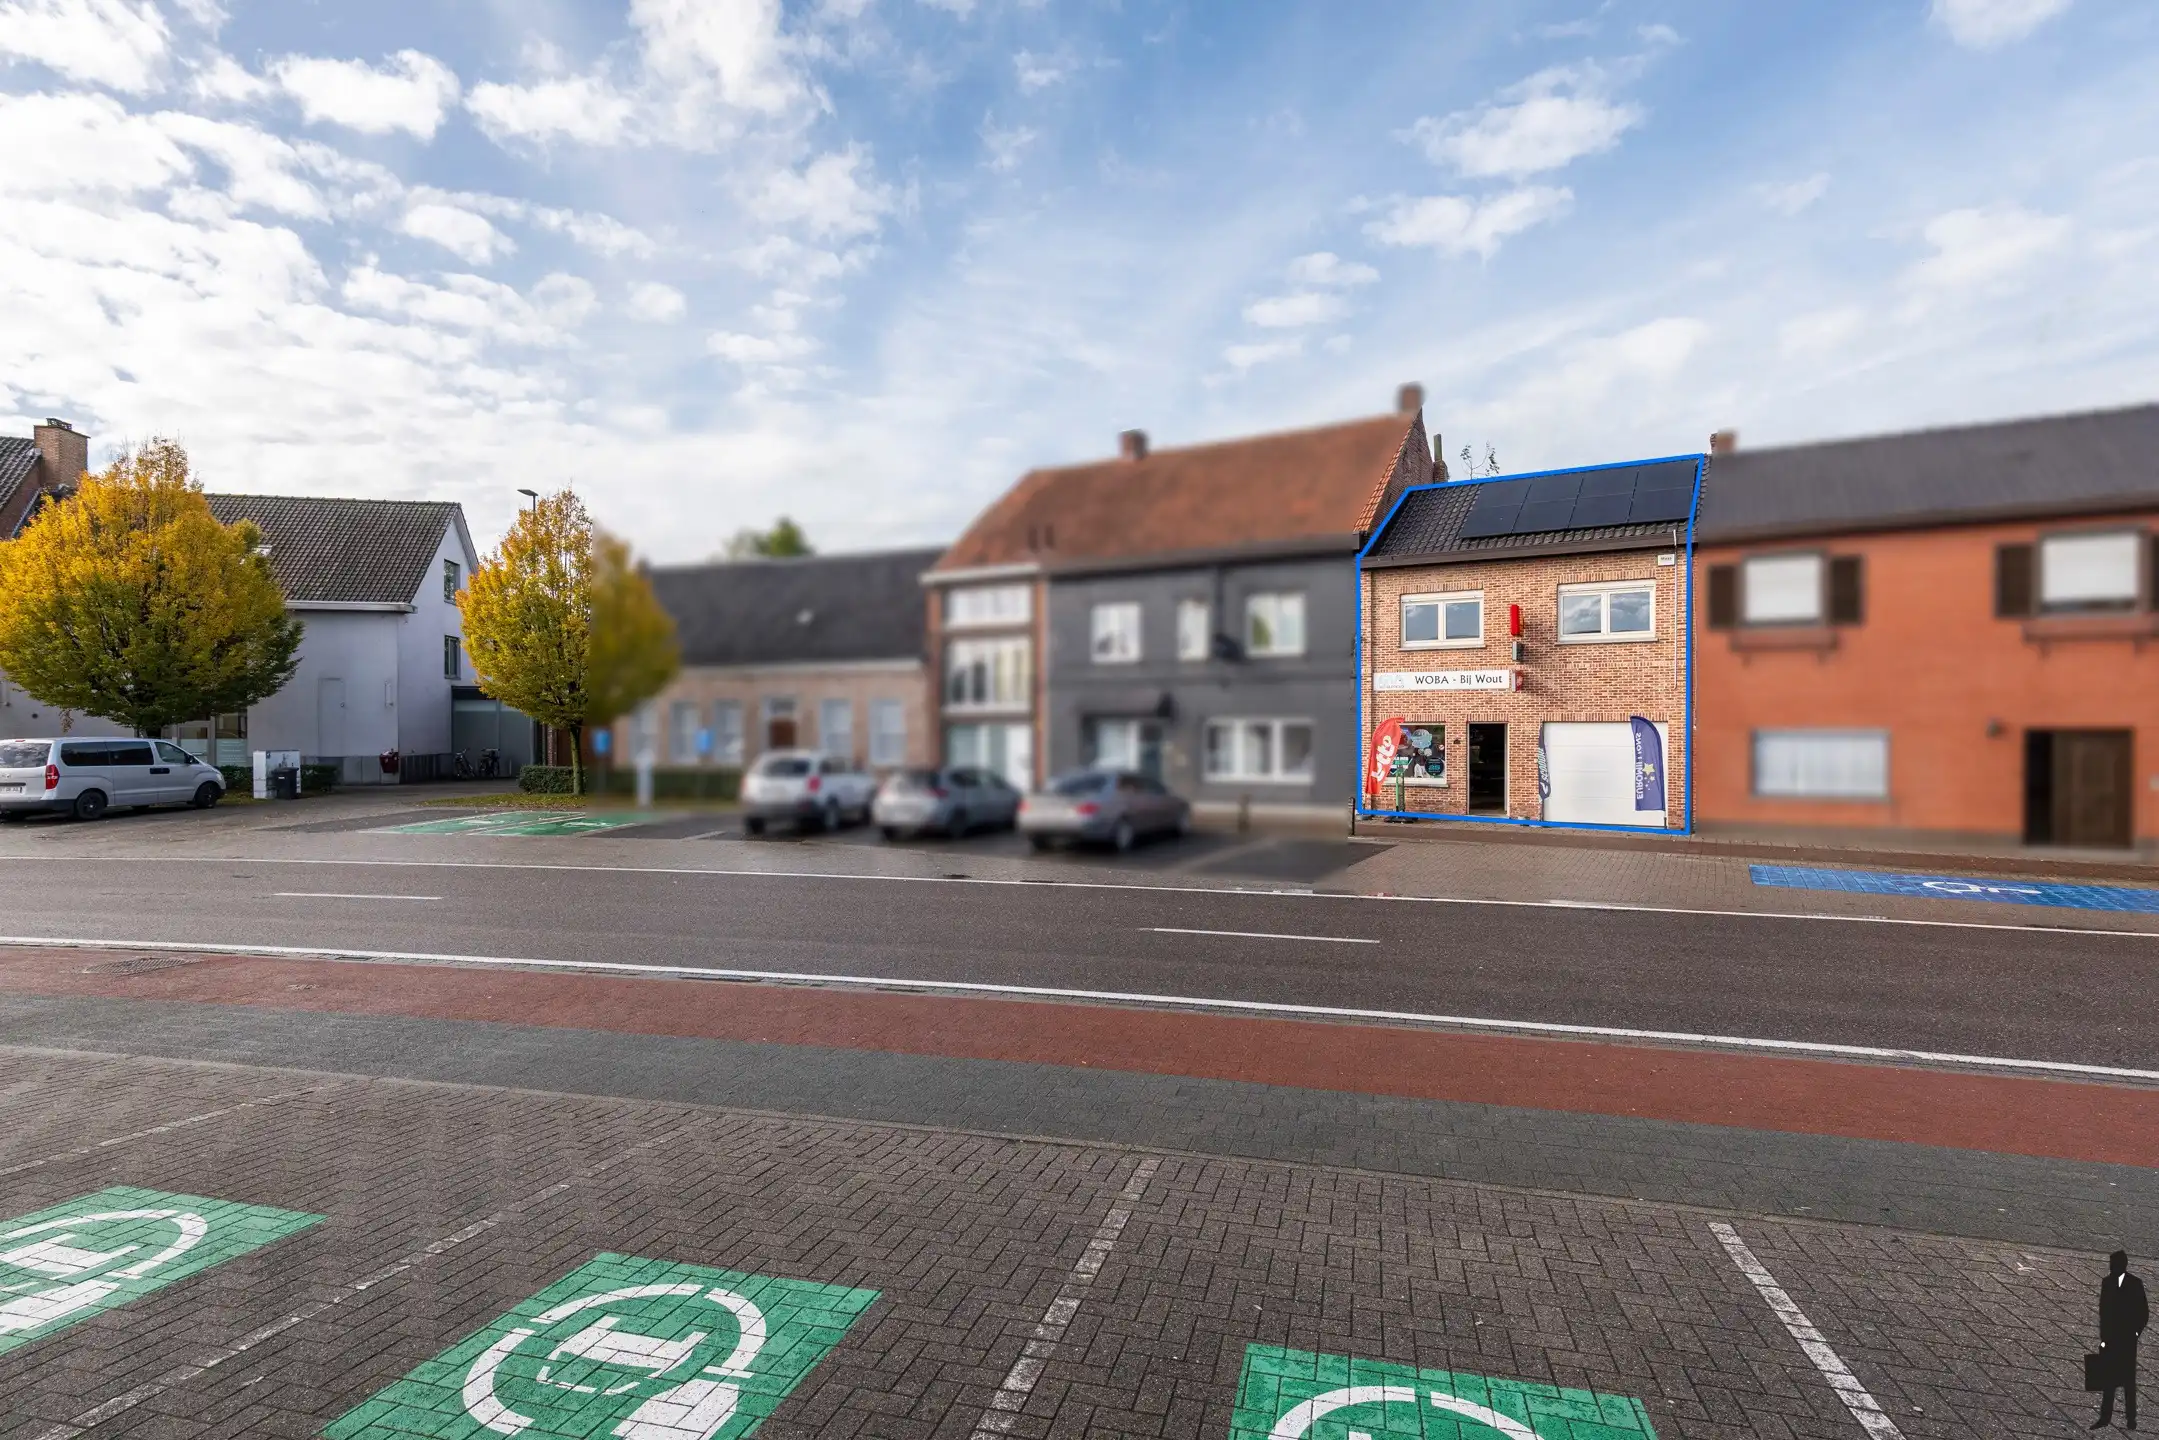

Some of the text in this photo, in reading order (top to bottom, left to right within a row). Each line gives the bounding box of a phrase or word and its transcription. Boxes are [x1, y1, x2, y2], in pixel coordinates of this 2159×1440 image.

[1415, 675, 1449, 685] WOBA
[1460, 675, 1472, 686] Bij
[1475, 674, 1503, 684] Wout
